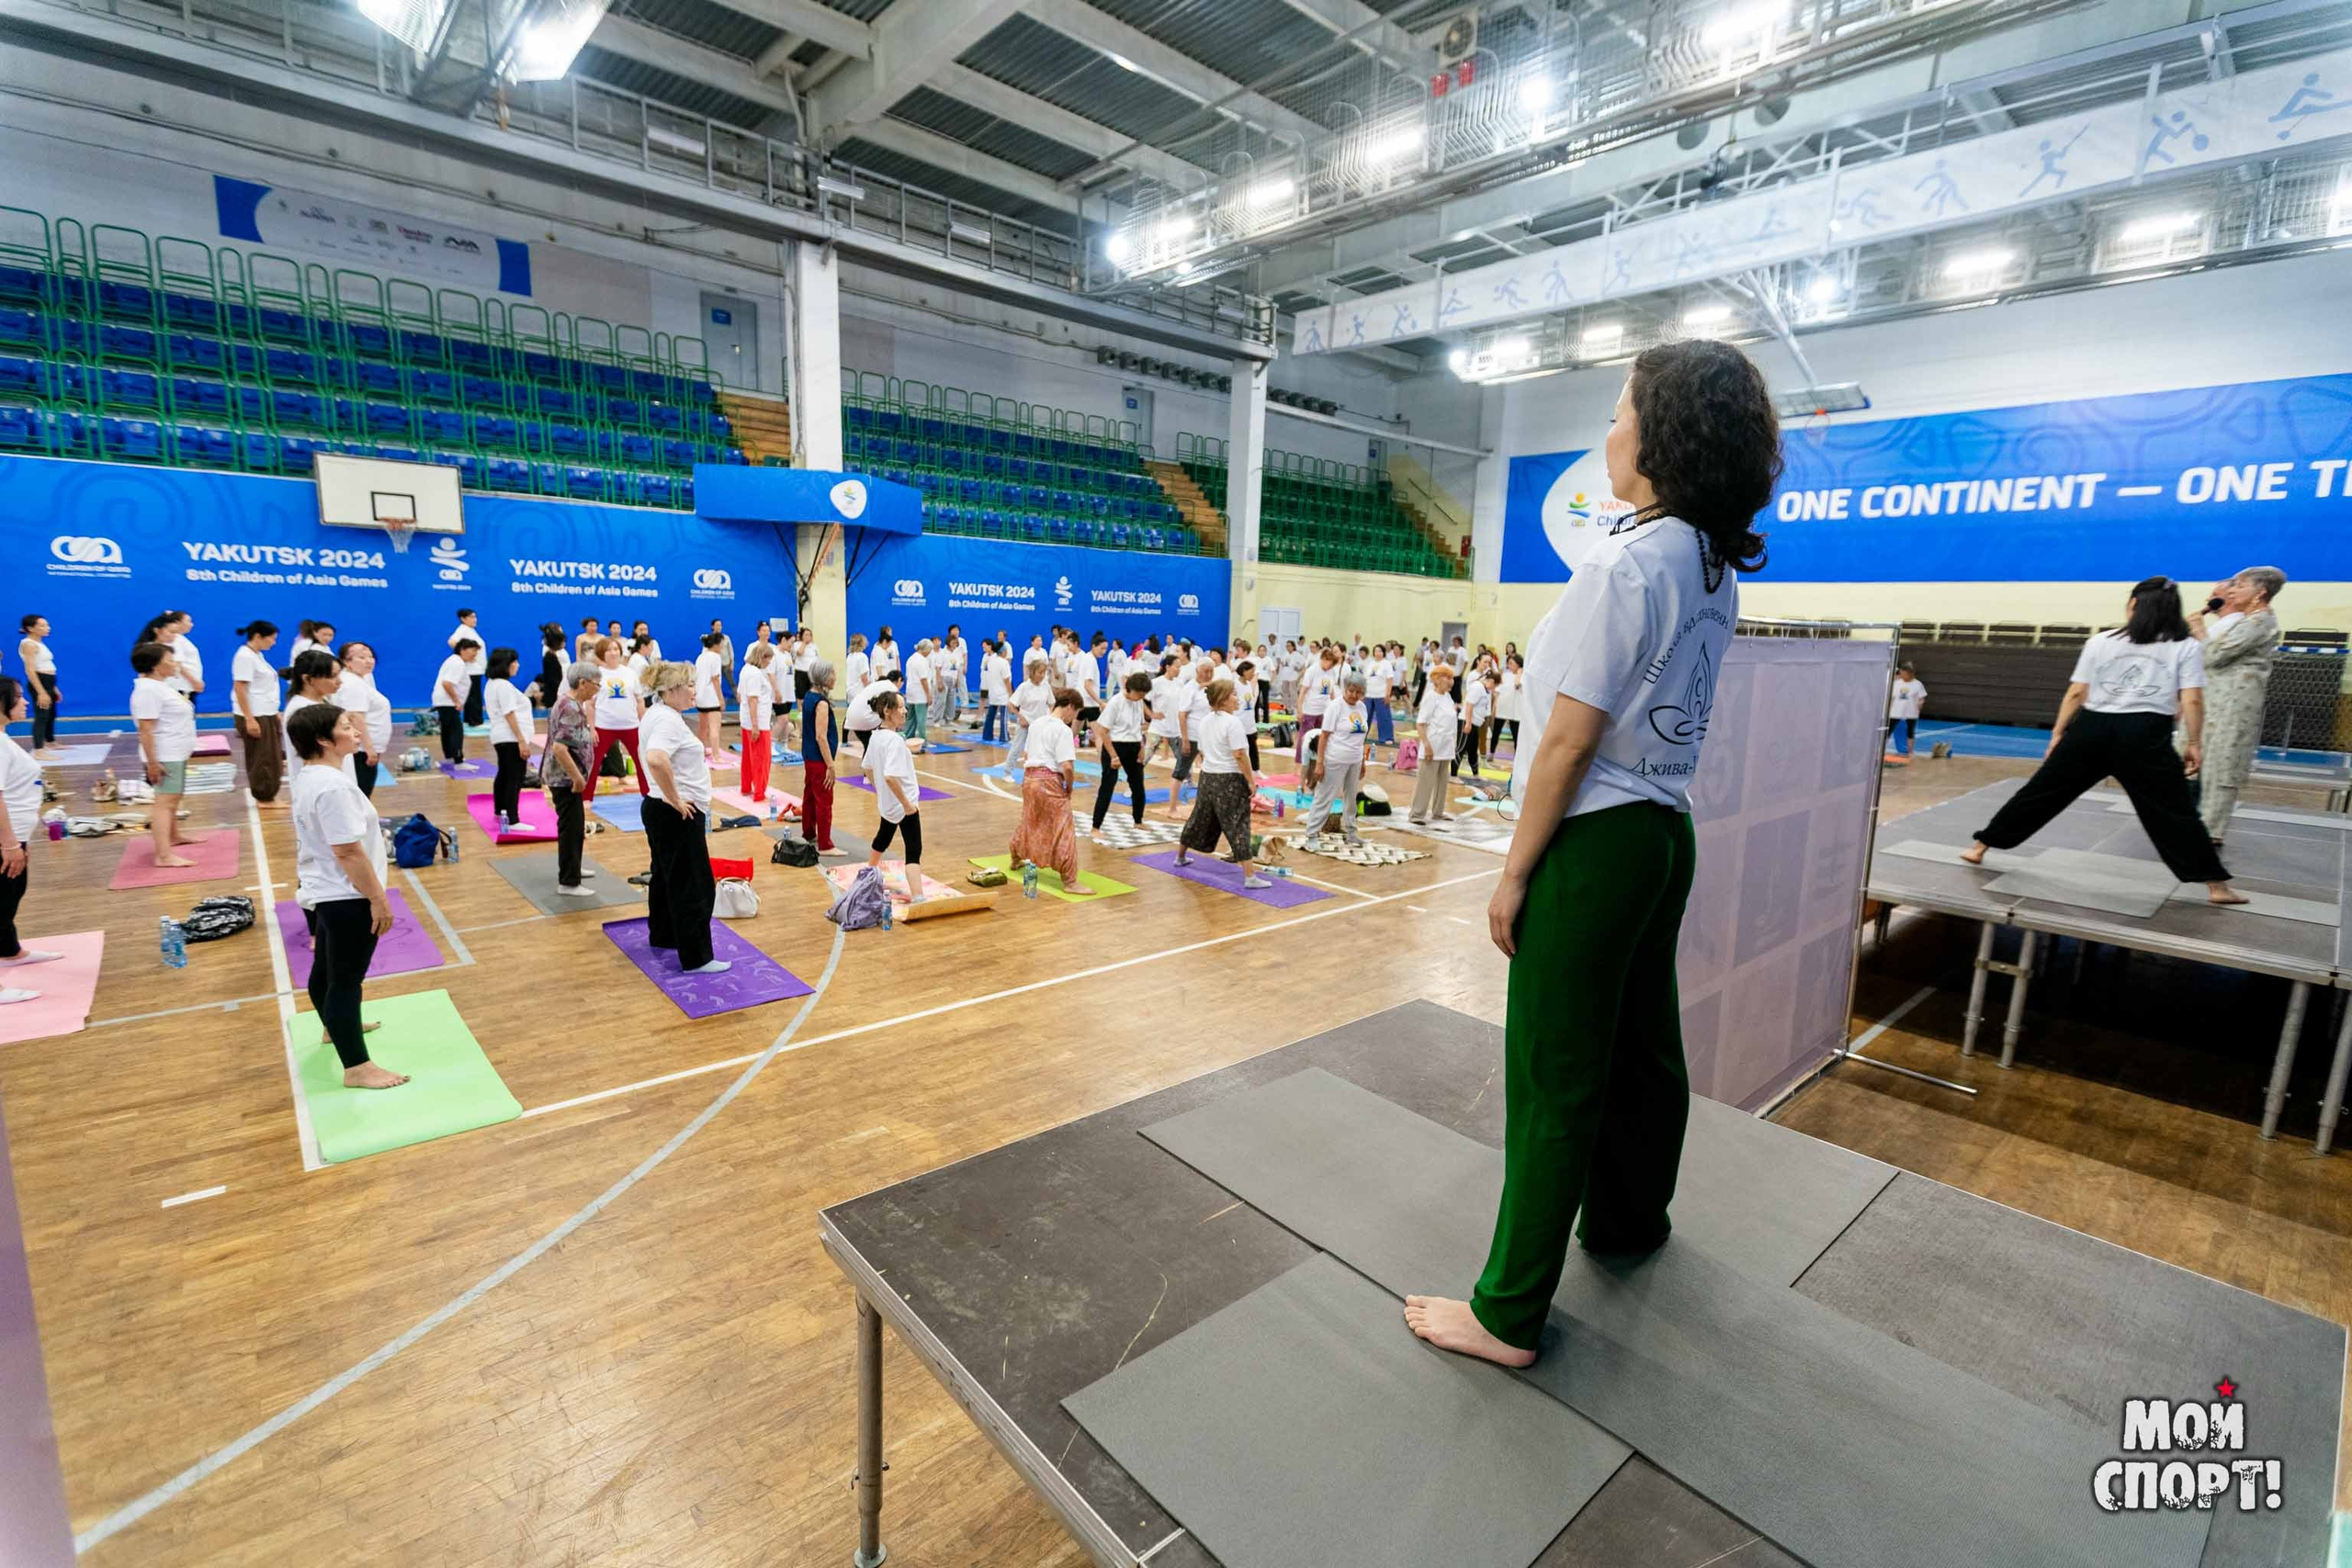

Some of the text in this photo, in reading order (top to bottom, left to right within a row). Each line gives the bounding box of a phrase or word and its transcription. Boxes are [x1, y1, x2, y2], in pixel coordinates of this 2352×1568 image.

[1778, 489, 1852, 521] ONE
[1860, 473, 2107, 517] CONTINENT
[2177, 462, 2294, 503] ONE
[2310, 459, 2352, 497] T
[182, 542, 386, 570] YAKUTSK 2024
[509, 558, 657, 581] YAKUTSK 2024
[219, 570, 284, 584] Children
[287, 572, 302, 584] of
[306, 573, 336, 586] Asia
[340, 574, 387, 588] Games
[535, 582, 582, 594] Children
[584, 584, 595, 595] of
[598, 585, 620, 596] Asia
[623, 586, 658, 598] Games
[948, 581, 1035, 599] YAKUTSK 2024
[1091, 590, 1162, 604] YAKUTSK 2024
[962, 600, 990, 609] Children
